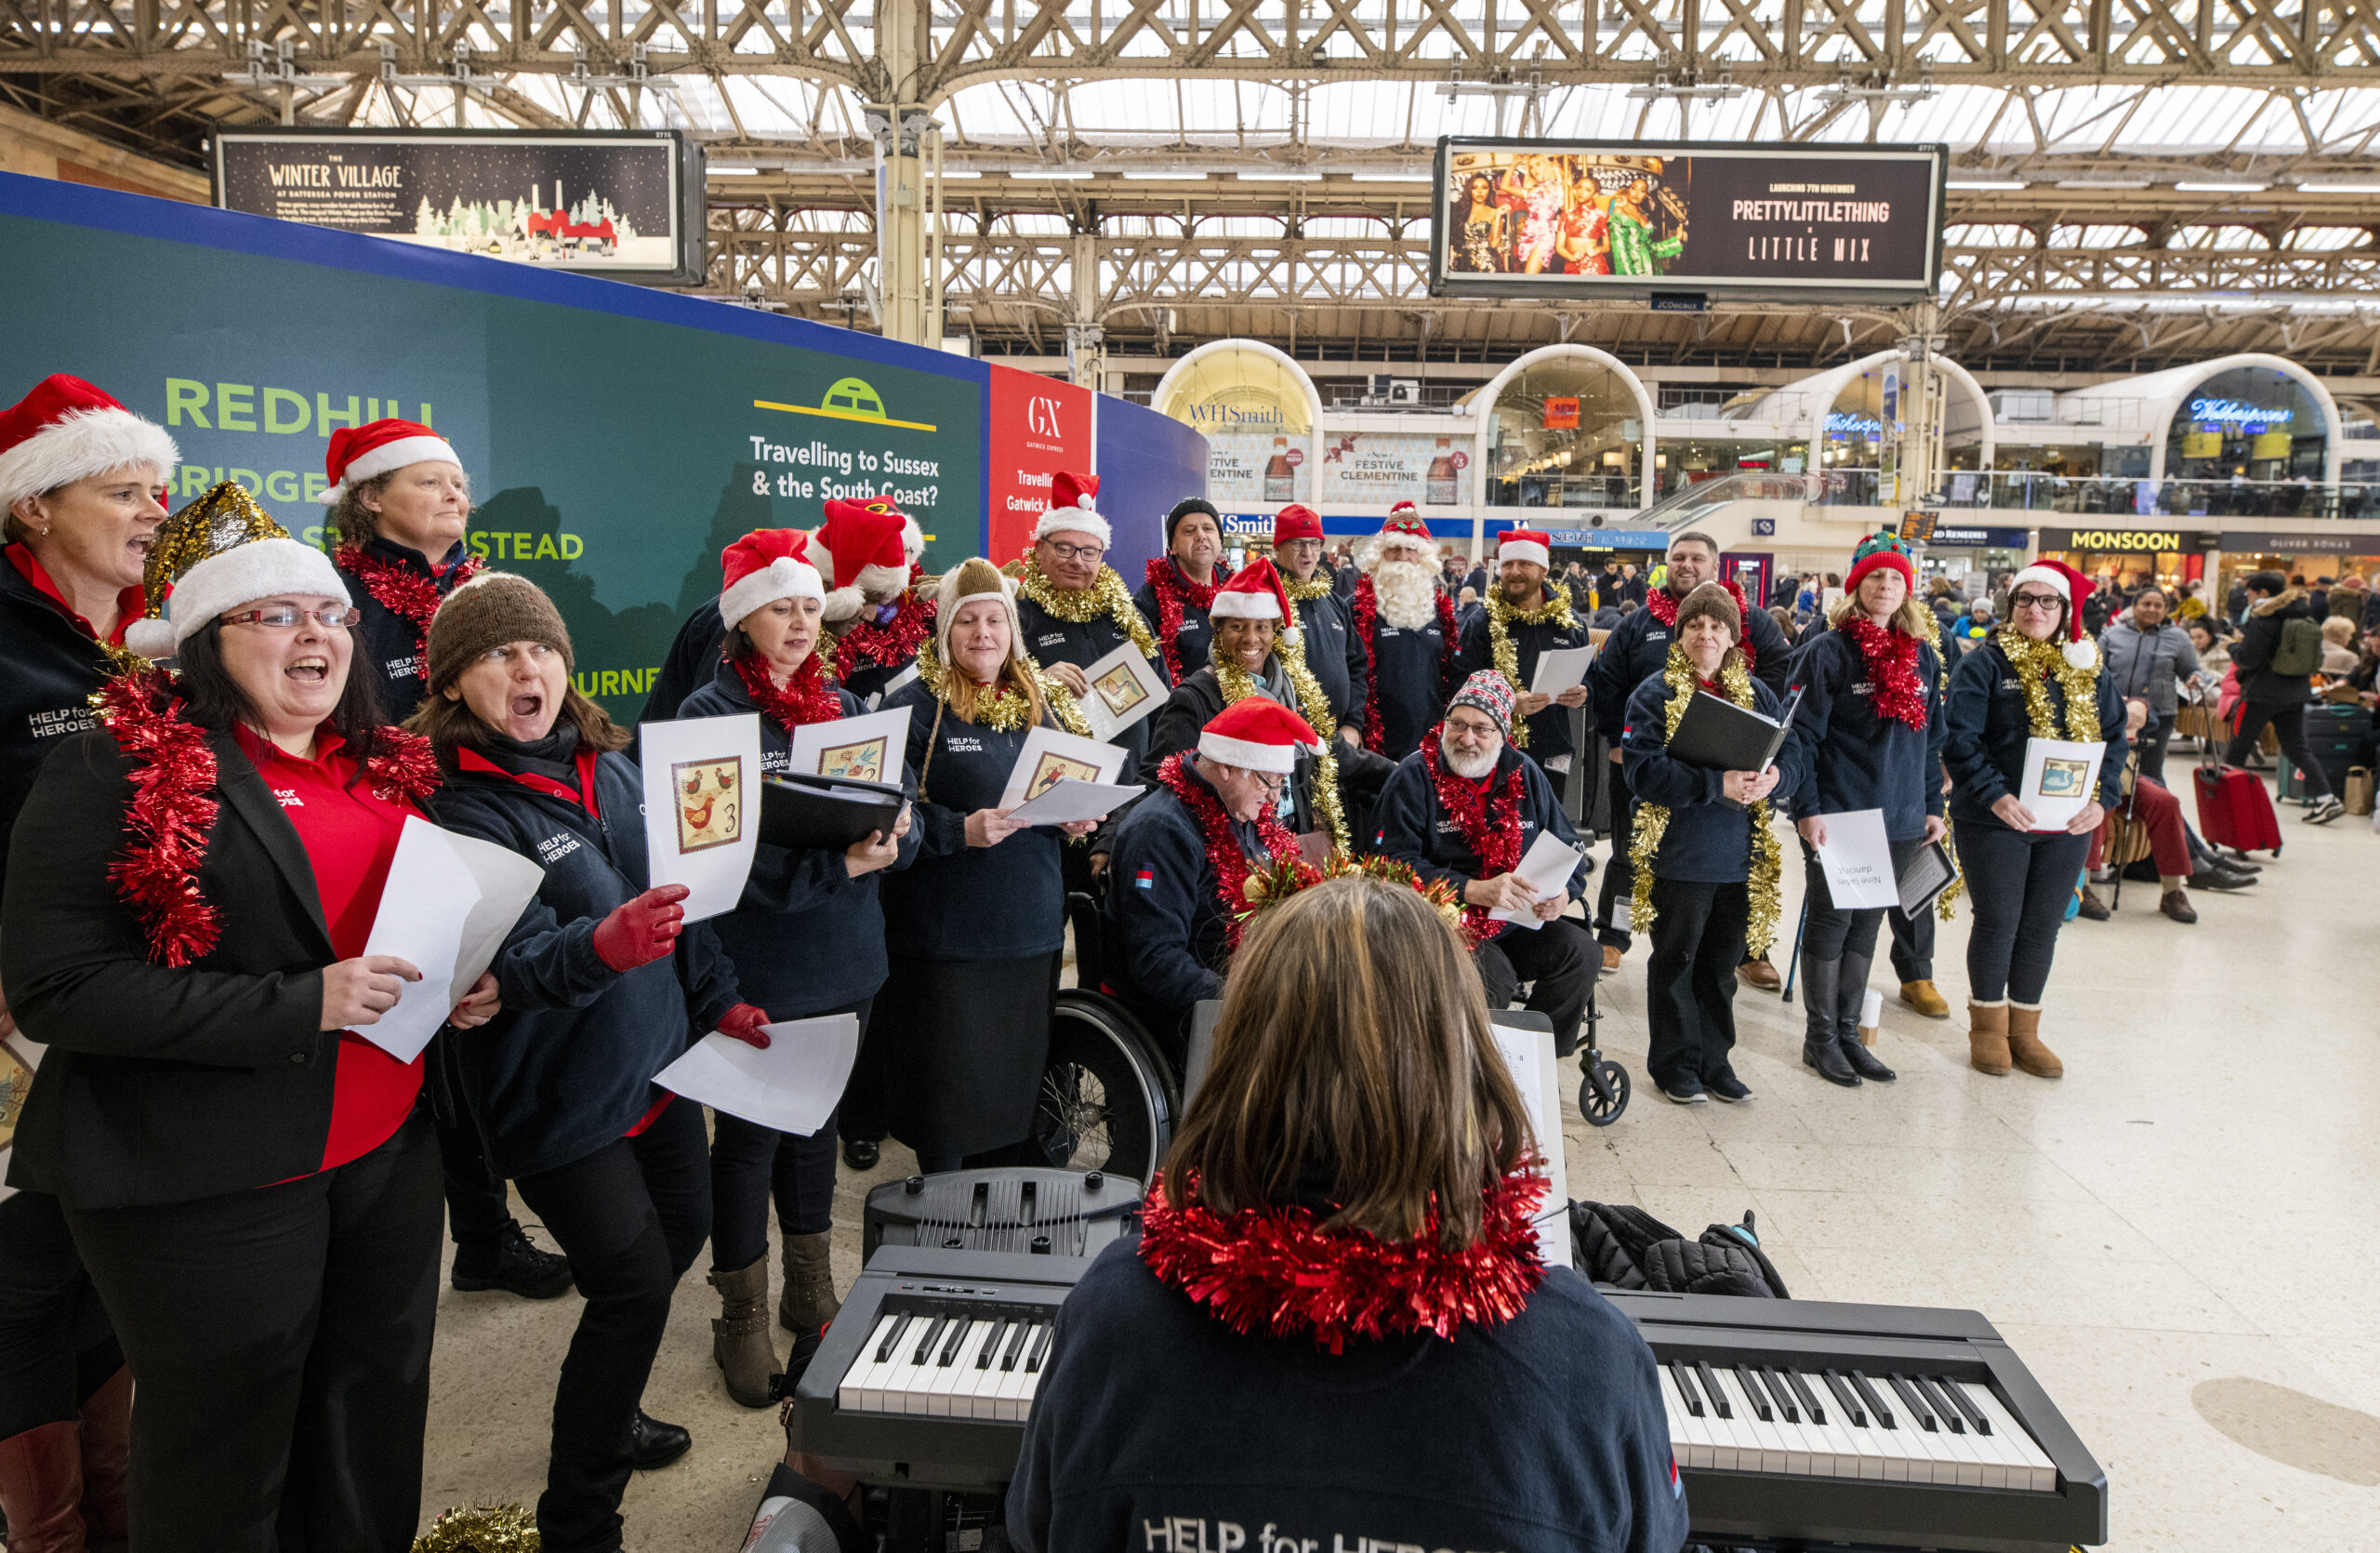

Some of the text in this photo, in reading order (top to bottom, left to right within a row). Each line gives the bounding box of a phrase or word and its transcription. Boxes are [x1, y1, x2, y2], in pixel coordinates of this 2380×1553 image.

[328, 154, 343, 163] THE
[269, 165, 403, 188] WINTER VILLAGE
[277, 190, 286, 198] AT
[289, 191, 331, 199] BATTERSEA
[364, 191, 397, 199] STATION
[1769, 183, 1856, 194] LAUNCHING 7TH NOVEMBER
[1733, 200, 1890, 223] PRETTYLITTLETHING
[1749, 236, 1870, 262] LITTLE MIX
[1657, 300, 1698, 310] JCDecaux
[1028, 395, 1062, 438] GX
[1190, 404, 1284, 424] WHSmith
[1026, 441, 1064, 453] GATWICK EXPRESS
[749, 435, 939, 477] Travelling to Sussex
[1210, 458, 1239, 468] TIVE
[1355, 460, 1404, 471] FESTIVE
[1341, 471, 1419, 482] CLEMENTINE
[166, 465, 346, 503] RIDGE
[752, 471, 938, 507] & the South Coast?
[1007, 495, 1044, 512] Gatwick
[1550, 531, 1594, 544] NERO
[1945, 529, 1988, 539] REMEDIES
[462, 530, 584, 560] STEAD
[2071, 531, 2180, 551] MONSOON
[2269, 538, 2308, 549] OLIVER
[1038, 633, 1054, 642] HELP
[1039, 637, 1065, 647] HEROES
[386, 657, 412, 670] HELP
[29, 707, 92, 725] HELP for
[32, 718, 97, 738] HEROES
[969, 737, 980, 745] for
[948, 744, 983, 752] HEROES
[774, 750, 787, 759] for
[760, 759, 790, 771] EROES
[274, 789, 296, 798] for
[722, 803, 736, 833] 3
[537, 832, 572, 855] HELP for
[543, 840, 581, 865] HEROES
[1838, 866, 1872, 876] dancing
[1837, 876, 1882, 886] Nine ladies
[1144, 1516, 1246, 1553] HELP
[1259, 1522, 1318, 1553] for
